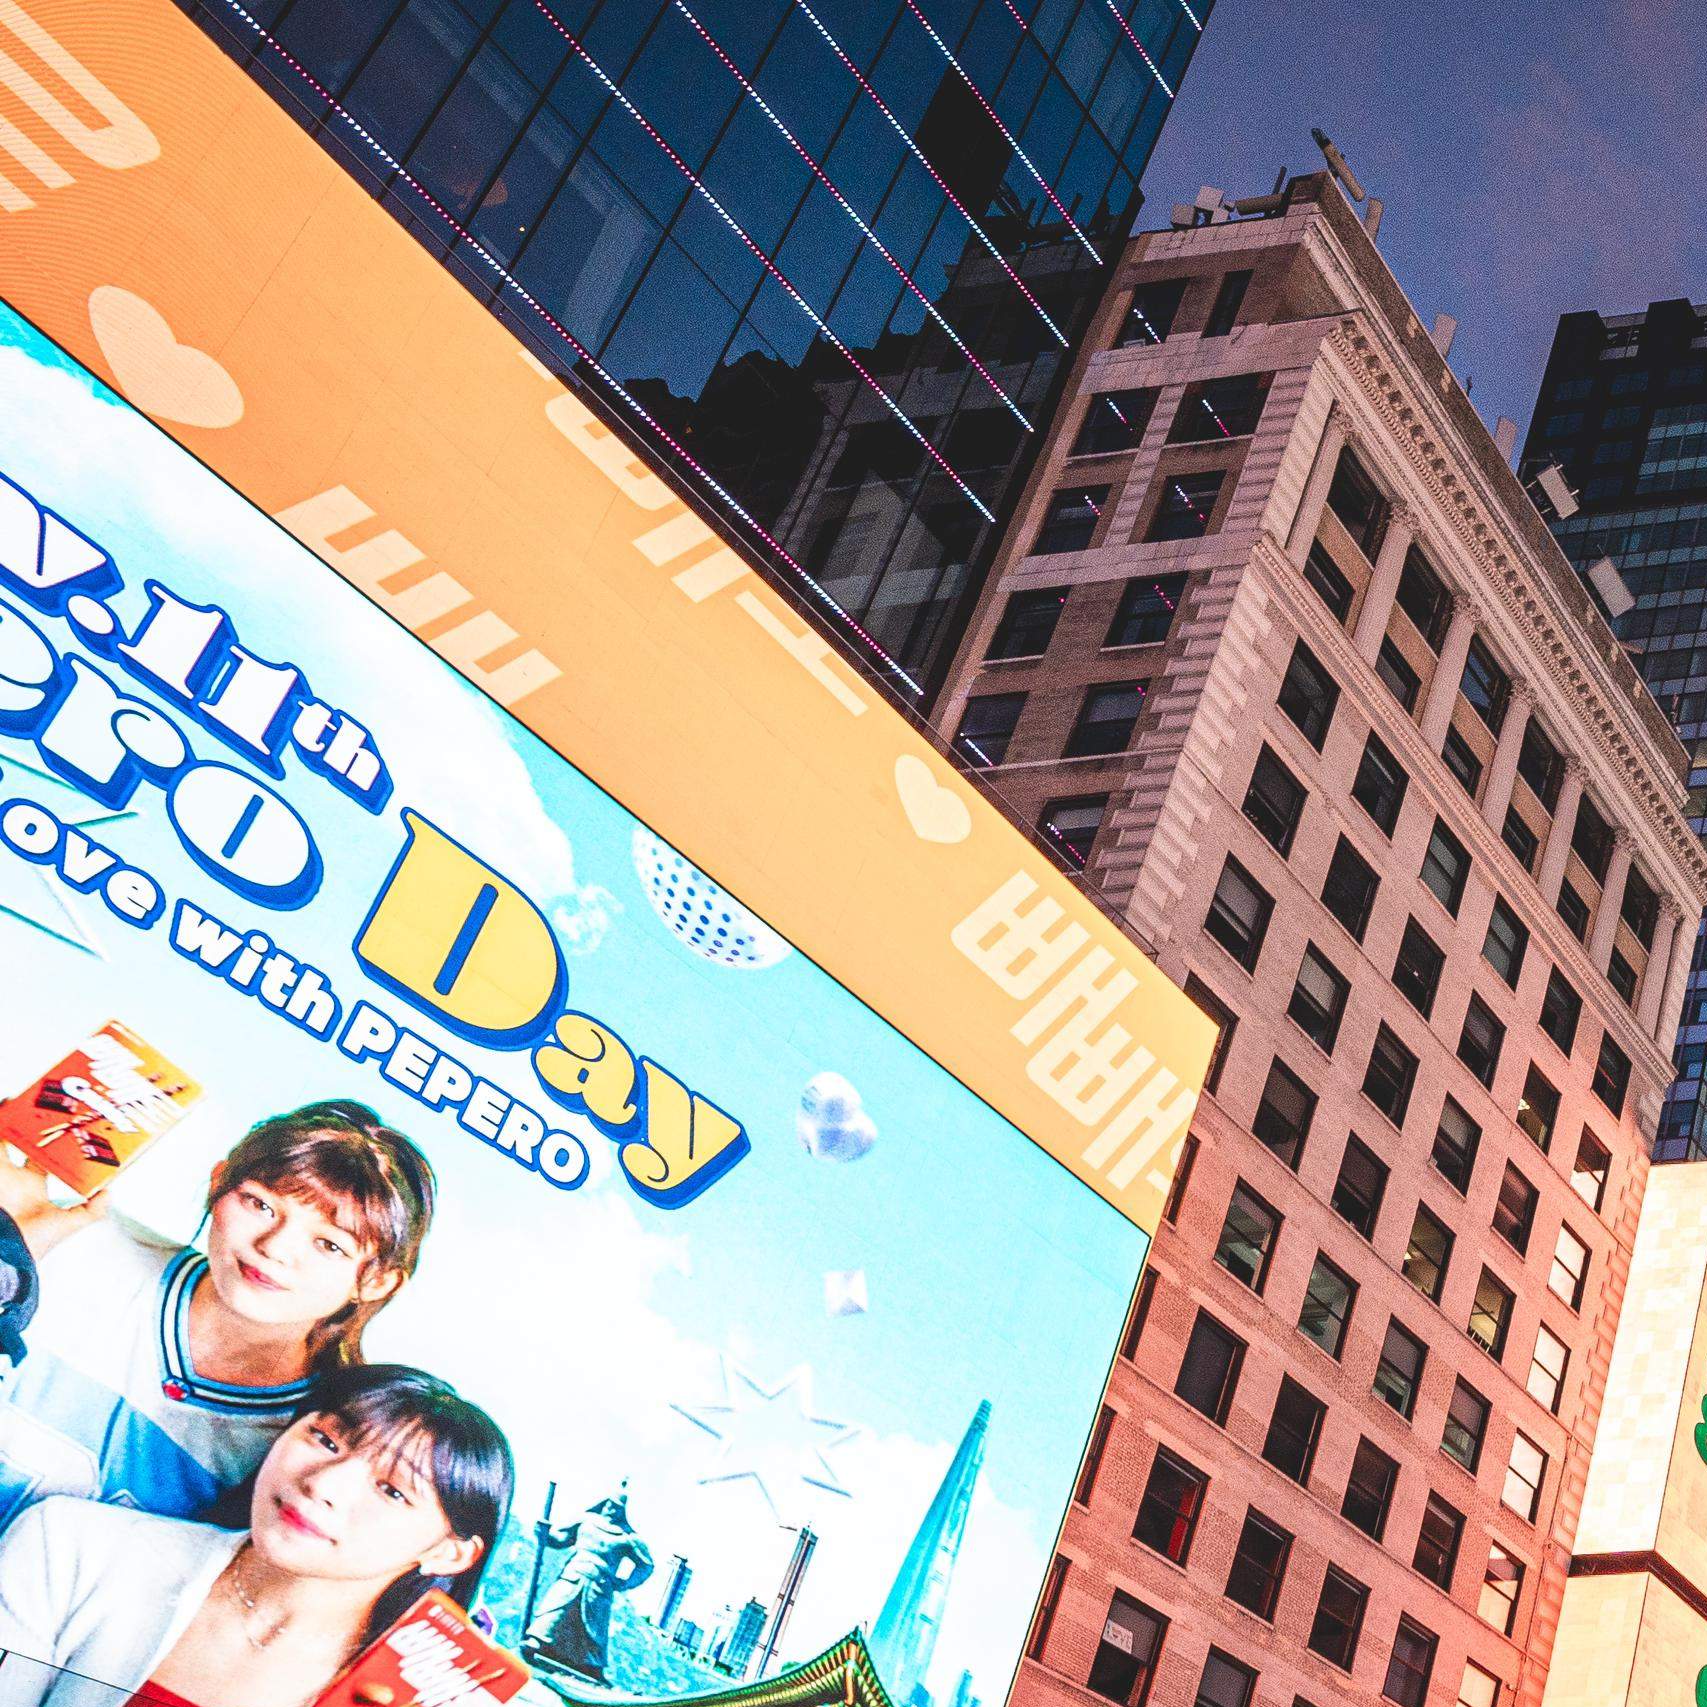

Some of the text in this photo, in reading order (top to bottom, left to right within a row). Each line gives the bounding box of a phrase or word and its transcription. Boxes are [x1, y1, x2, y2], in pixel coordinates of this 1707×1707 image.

[173, 901, 337, 1038] with
[341, 1005, 587, 1187] PEPERO
[355, 808, 748, 1205] Day
